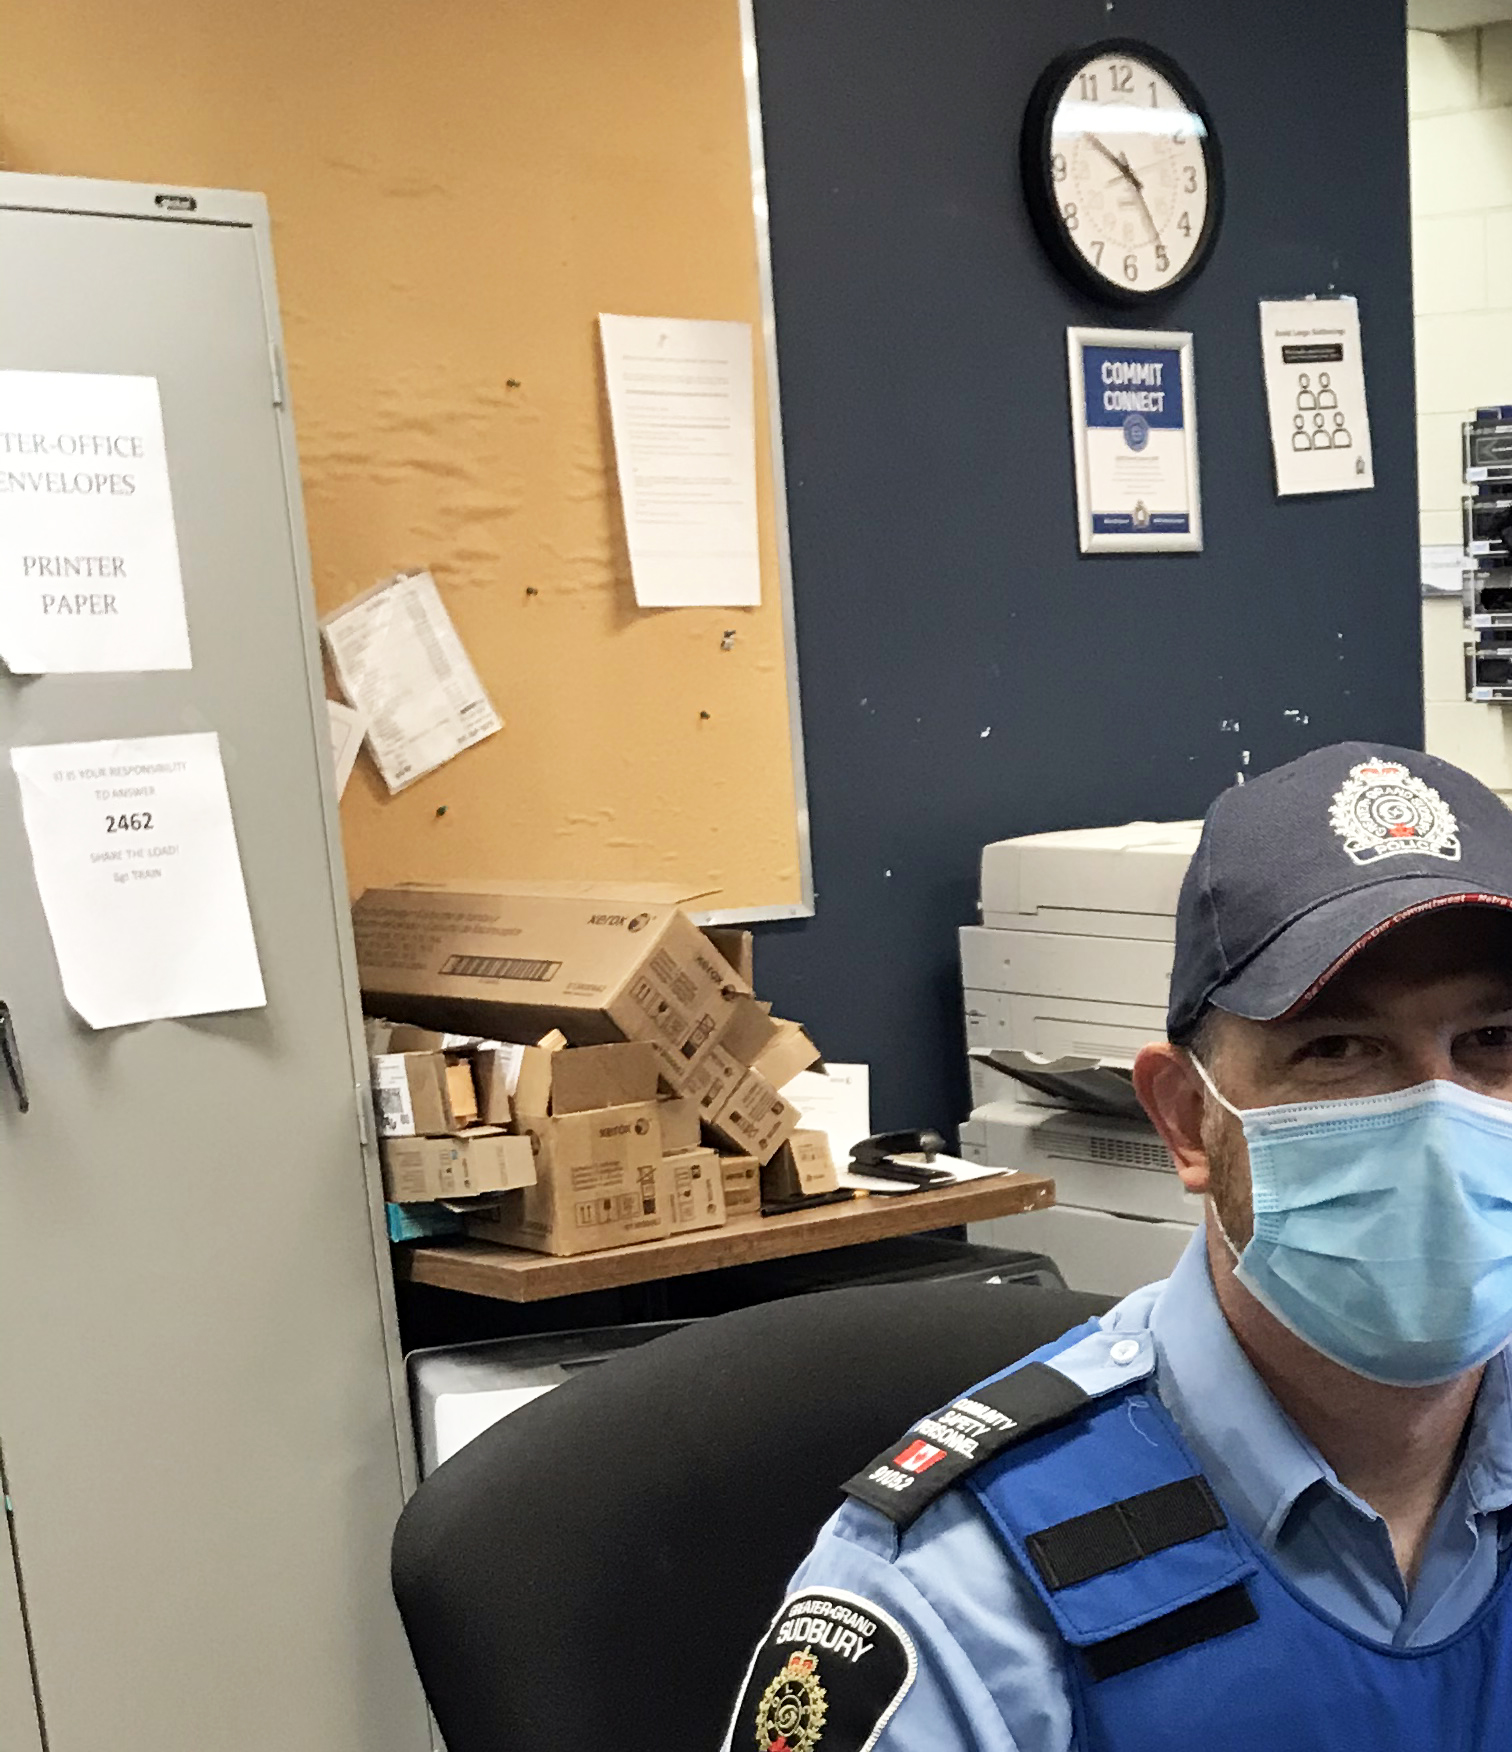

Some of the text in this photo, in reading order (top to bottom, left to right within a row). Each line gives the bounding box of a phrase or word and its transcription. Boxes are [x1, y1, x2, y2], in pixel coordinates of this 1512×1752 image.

[1079, 73, 1098, 101] 11
[1109, 65, 1135, 93] 12
[1148, 81, 1158, 108] 1
[1051, 153, 1068, 182] 9
[1182, 166, 1198, 193] 3
[1064, 202, 1080, 231] 8
[1176, 211, 1192, 238] 4
[1090, 241, 1105, 267] 7
[1154, 244, 1170, 272] 5
[1122, 254, 1138, 282] 6
[1101, 360, 1163, 386] COMMIT
[1103, 390, 1165, 412] CONNECT
[0, 432, 144, 458] TER-OFFICE
[0, 471, 136, 495] ENVELOPES
[22, 555, 127, 578] PRINTER
[41, 593, 119, 615] PAPER
[1366, 787, 1414, 800] GRAND
[105, 812, 154, 833] 2462
[1374, 839, 1440, 855] POLICE
[587, 914, 627, 926] xerox
[939, 1411, 992, 1438] SAFETY
[952, 1397, 1018, 1431] COMMUNITY
[914, 1419, 980, 1460] PERSONNEL
[868, 1465, 915, 1492] 91052
[774, 1616, 874, 1663] SUDBURY
